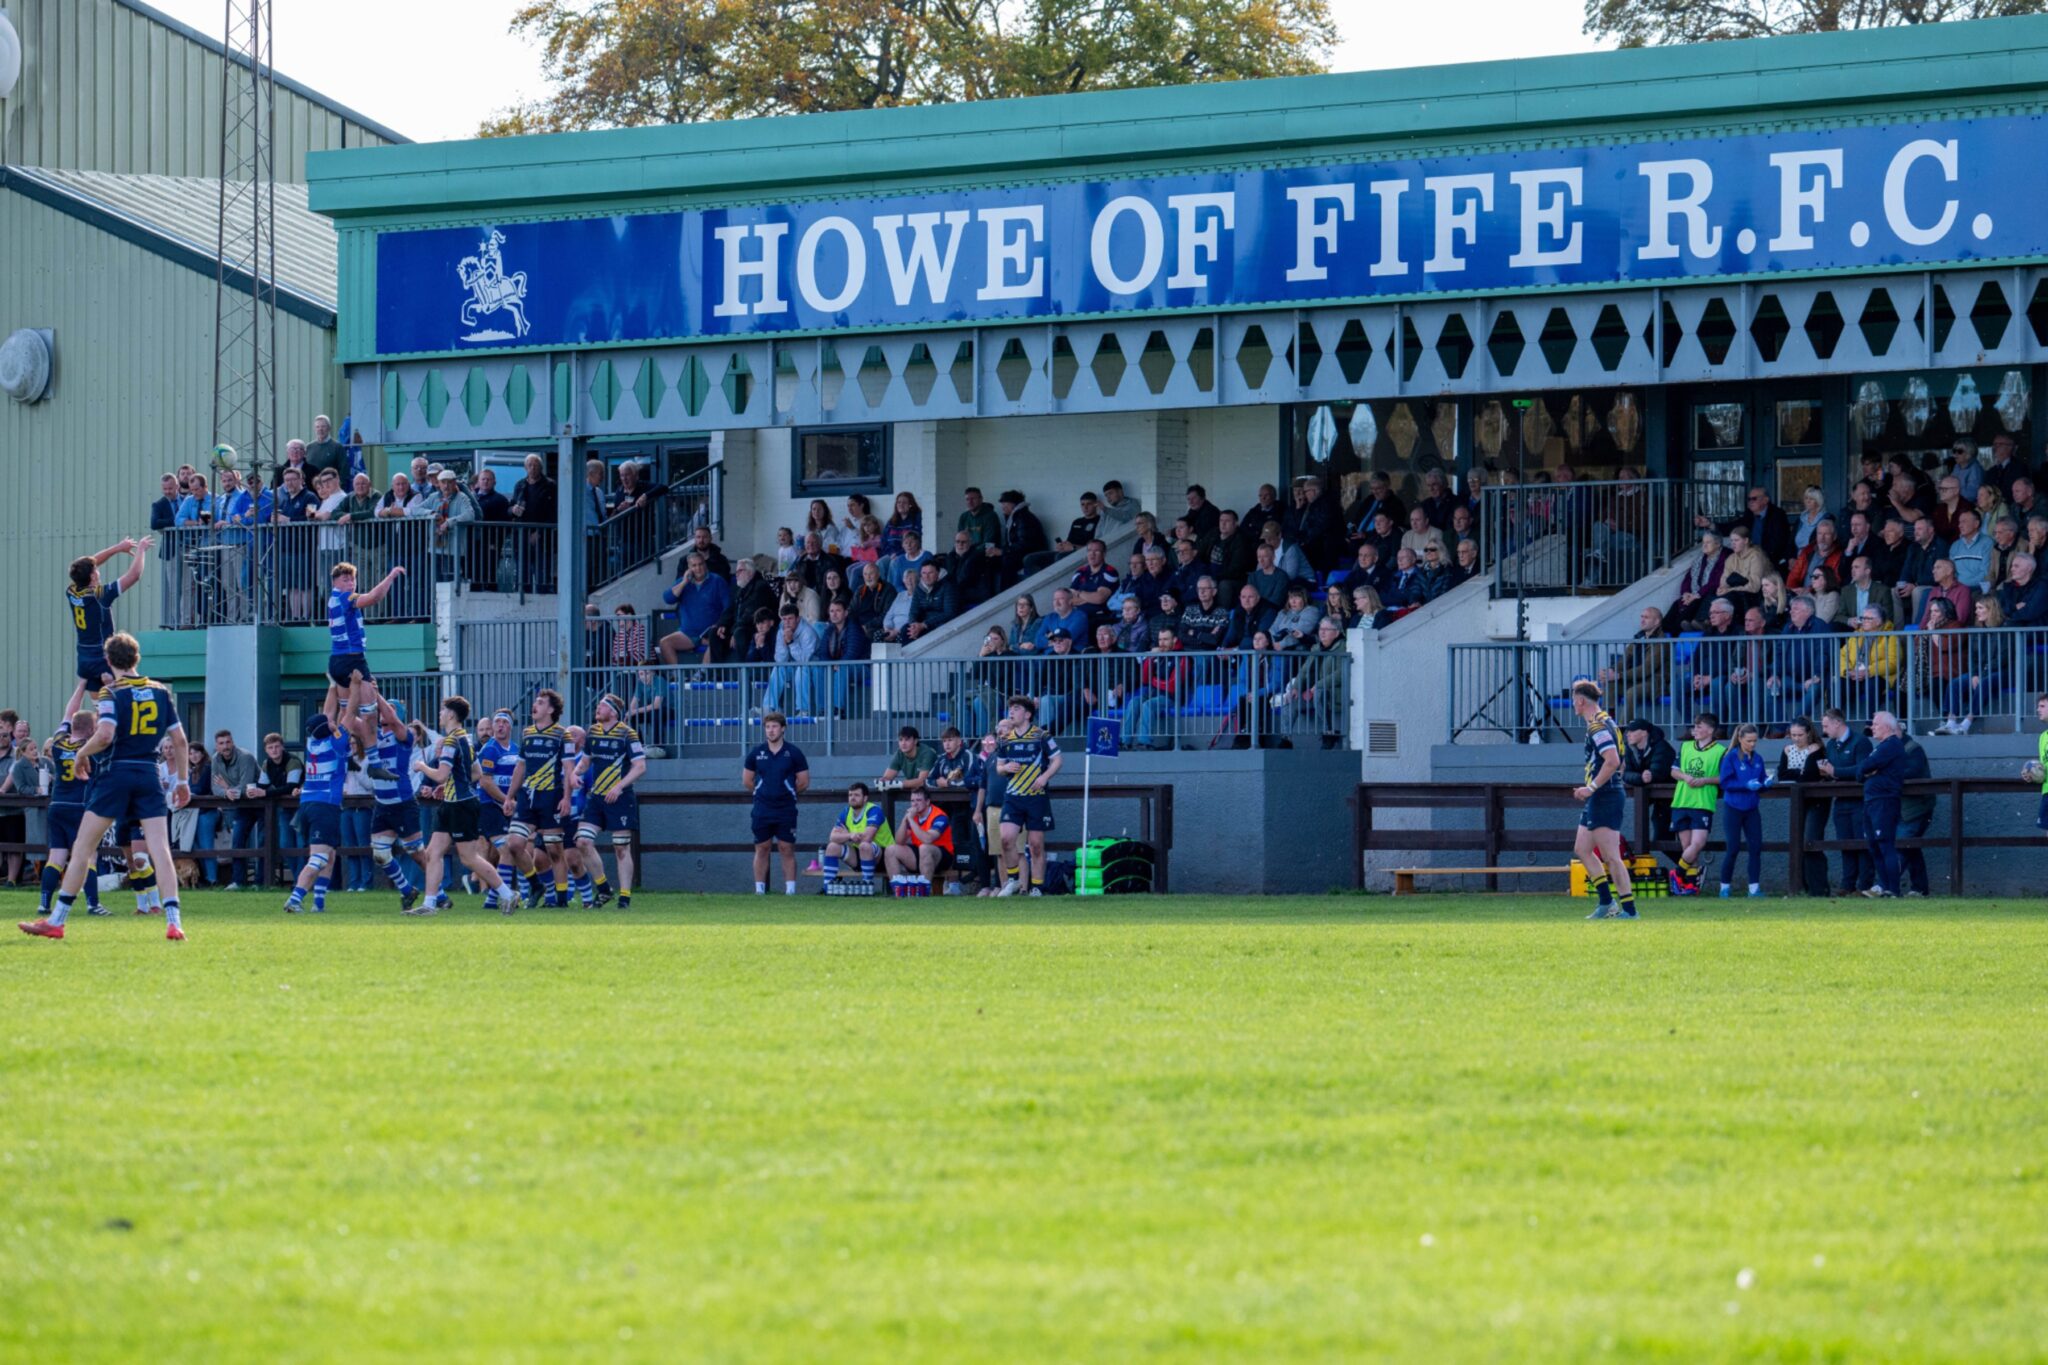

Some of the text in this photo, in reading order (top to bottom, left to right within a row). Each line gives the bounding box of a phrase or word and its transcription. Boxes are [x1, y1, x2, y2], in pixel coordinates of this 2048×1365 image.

[713, 138, 1994, 318] HOWE OF FIFE R.F.C.
[74, 606, 87, 630] 8
[129, 700, 158, 735] 12
[61, 760, 75, 781] 3
